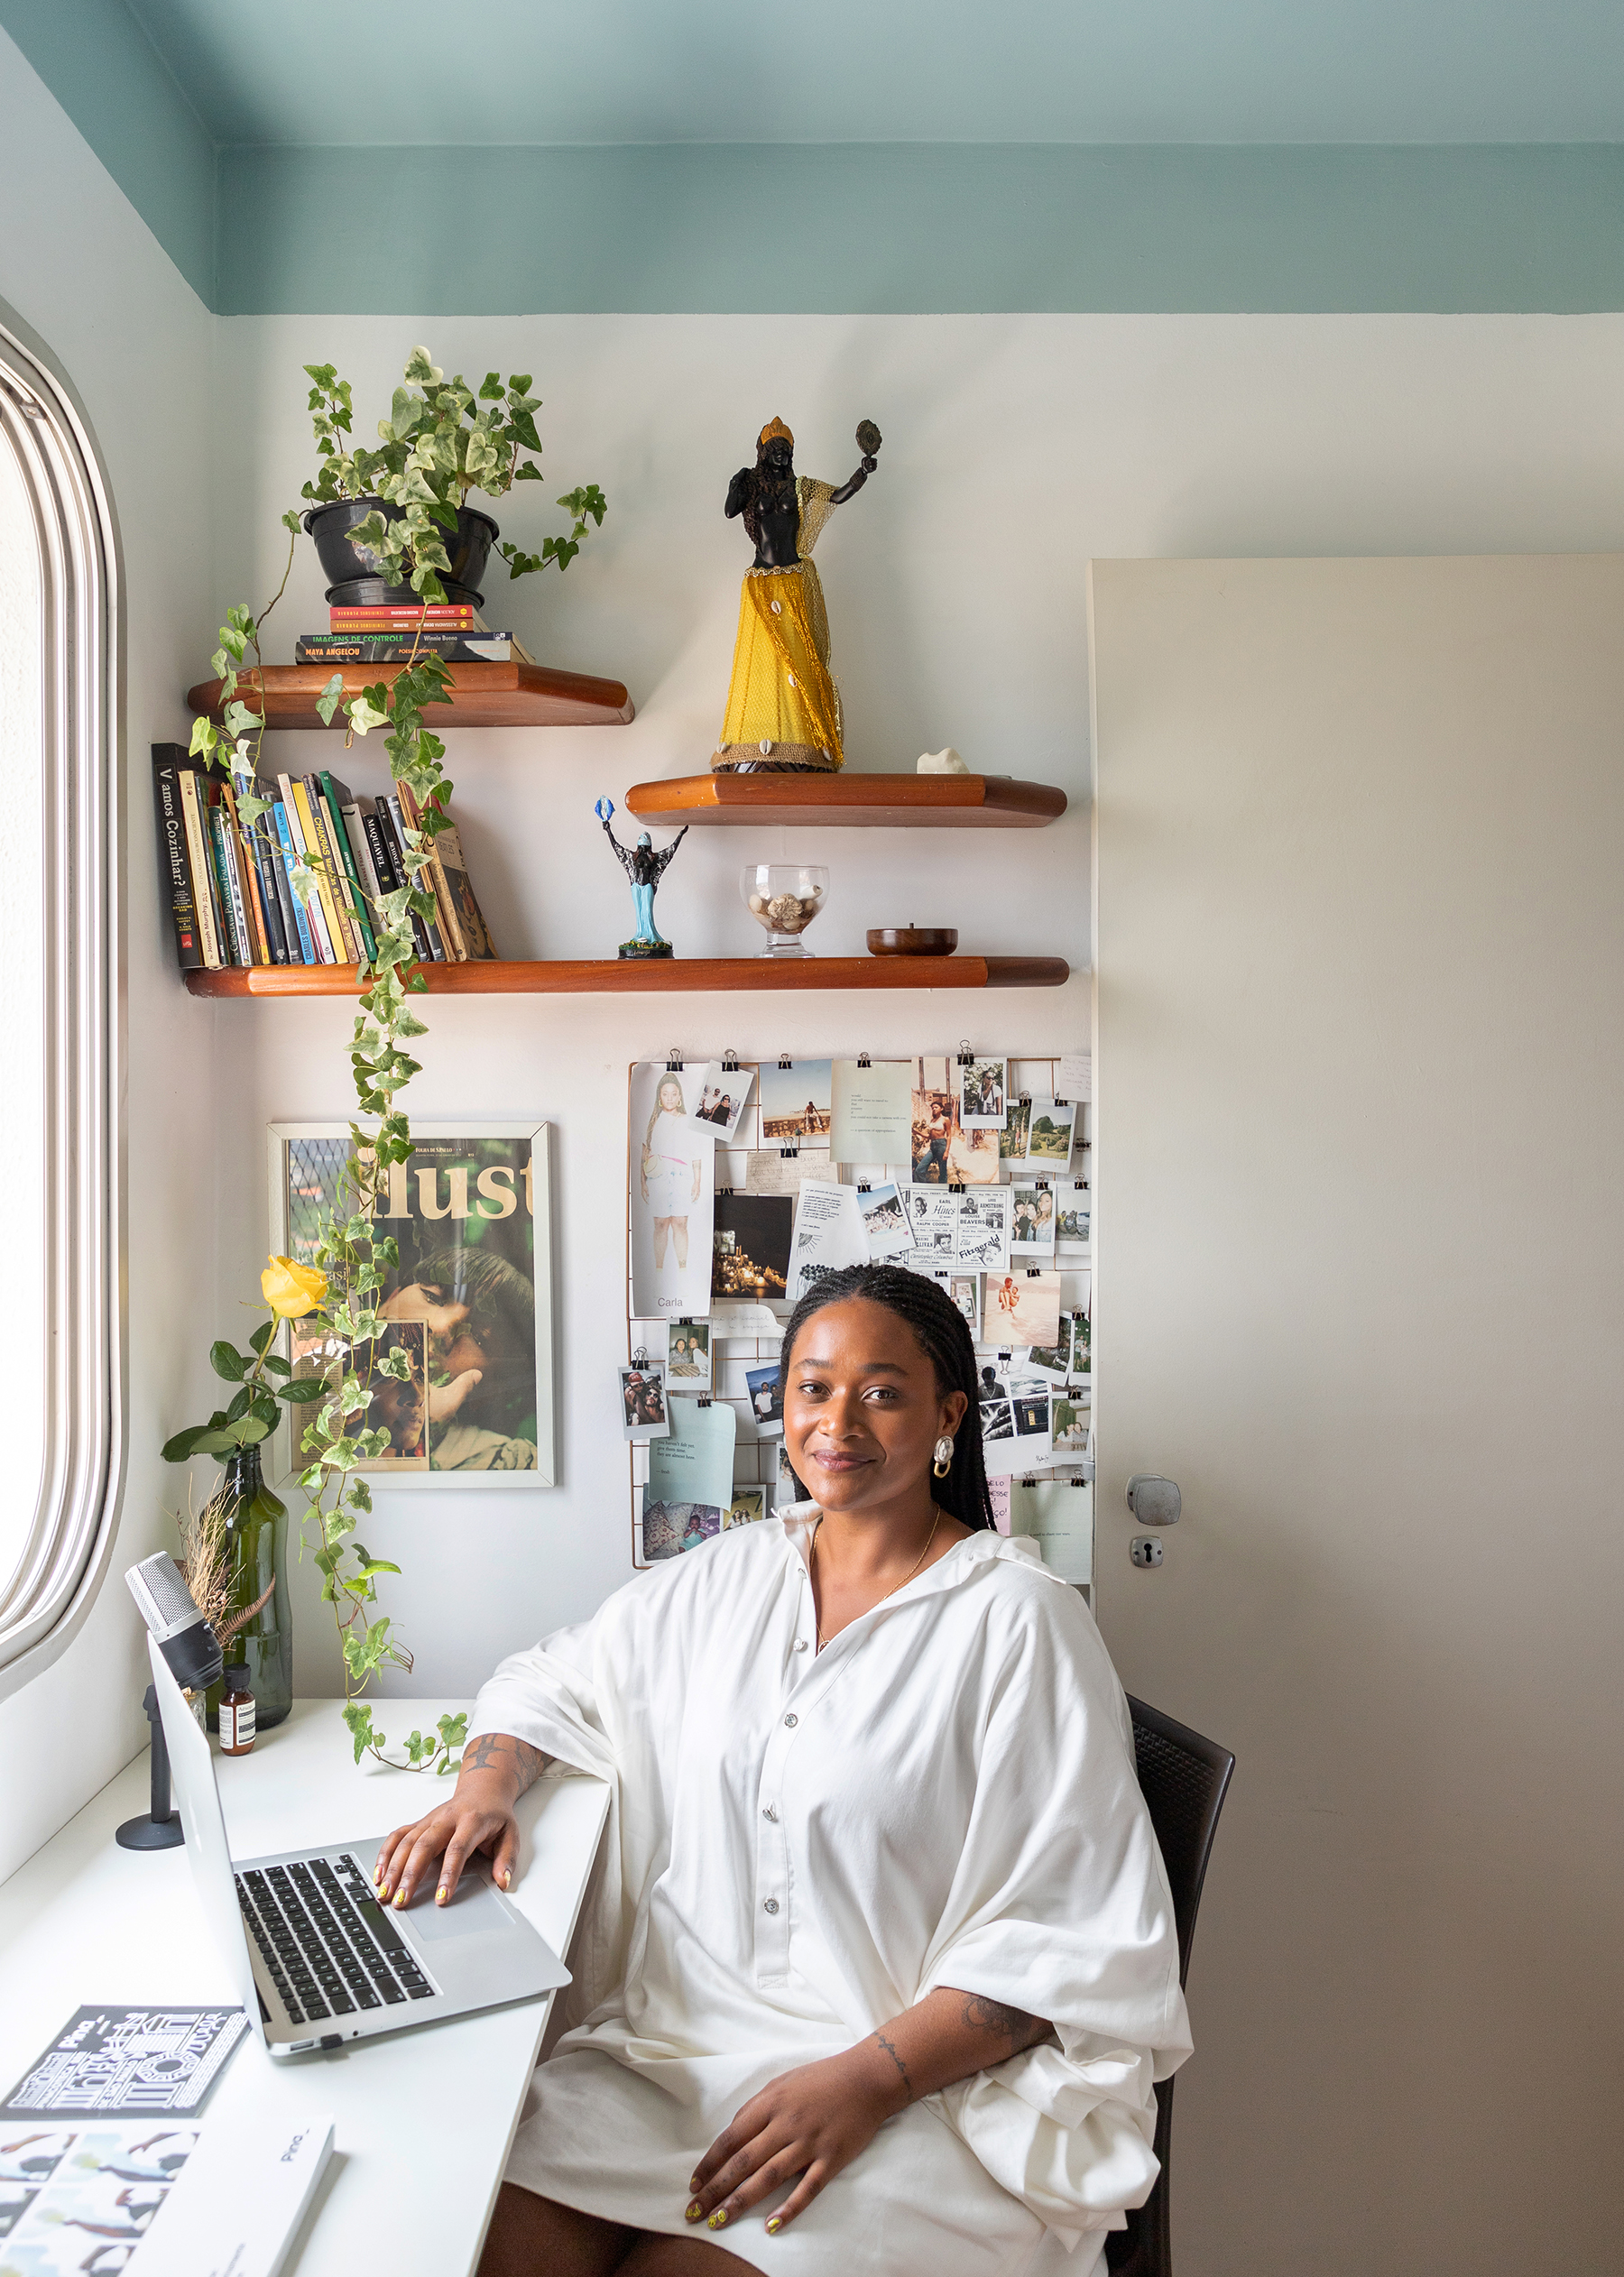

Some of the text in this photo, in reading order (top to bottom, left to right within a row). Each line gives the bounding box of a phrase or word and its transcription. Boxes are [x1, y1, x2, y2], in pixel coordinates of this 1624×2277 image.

[190, 814, 199, 853] SUBCONSCIENTE
[214, 816, 223, 844] PROPHET
[314, 817, 330, 856] CHAKRAS
[167, 821, 186, 886] Cozinhar?
[368, 819, 384, 868] MAQUIAVEL
[196, 854, 201, 862] DO
[218, 853, 228, 880] FALADA
[357, 850, 365, 867] FRANK
[325, 857, 337, 886] Mandas
[361, 868, 369, 881] ANNE
[224, 881, 233, 913] PALAVRA
[251, 885, 259, 908] Divina
[333, 887, 340, 896] de
[254, 909, 263, 931] Magia
[336, 897, 347, 925] Vitalidade
[205, 931, 213, 953] Joseph
[296, 908, 312, 960] CHARLES BUKOWSKI
[345, 932, 354, 949] Poder
[931, 1205, 956, 1214] Hines
[959, 1234, 1000, 1258] Fitzgerald
[325, 1267, 350, 1281] rasil
[657, 1297, 683, 1307] Carla
